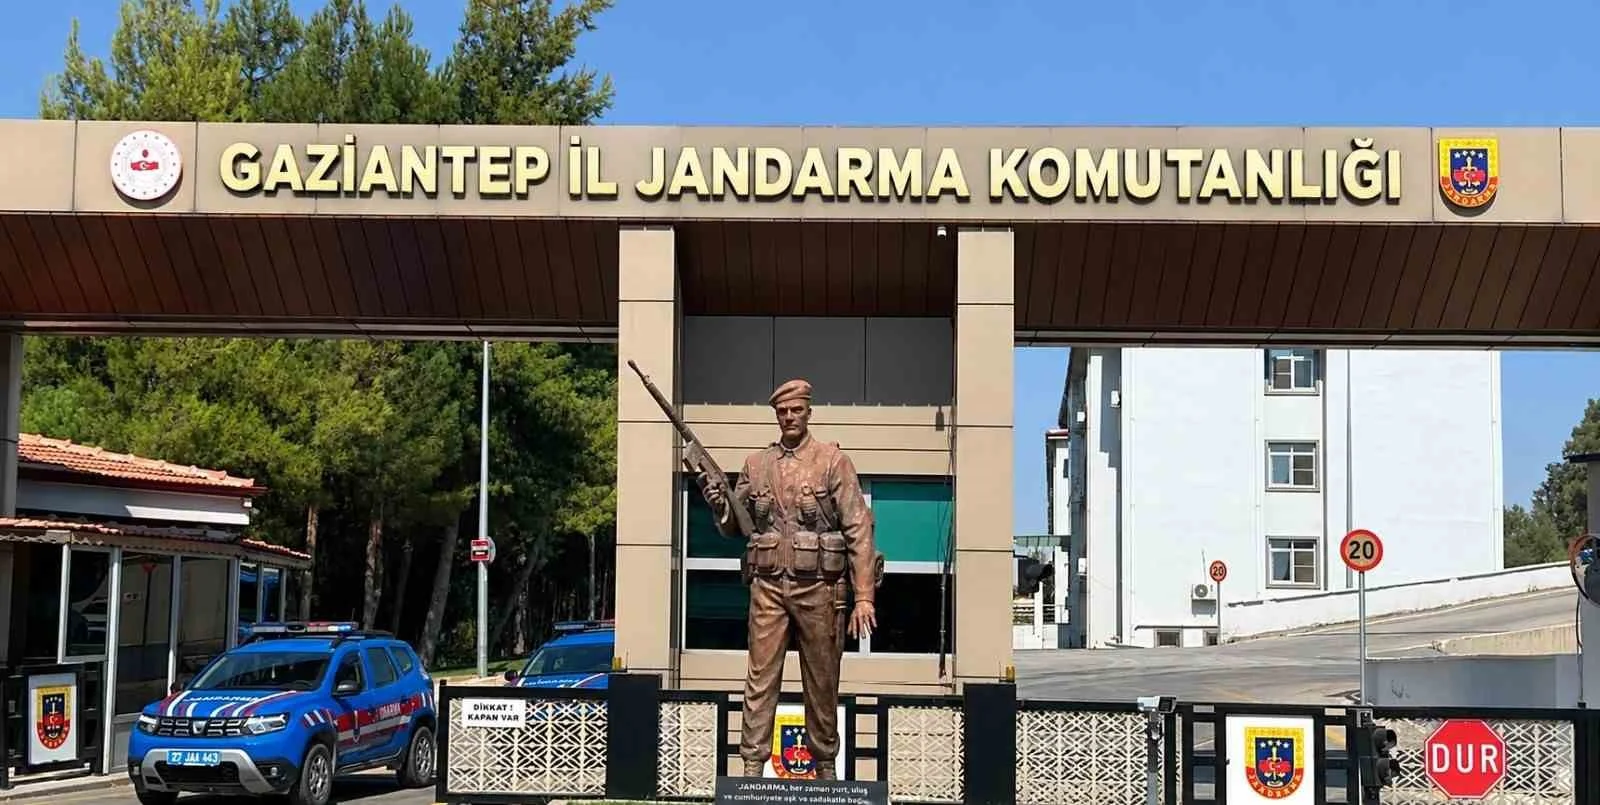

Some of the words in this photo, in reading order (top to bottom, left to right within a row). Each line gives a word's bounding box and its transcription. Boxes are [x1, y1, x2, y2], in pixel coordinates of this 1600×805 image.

[220, 134, 550, 194] GAZİANTEP
[569, 135, 618, 195] İL
[635, 146, 971, 197] JANDARMA
[989, 138, 1401, 199] KOMUTANLIĞI
[1349, 540, 1375, 560] 20
[1213, 566, 1224, 577] 20
[473, 702, 508, 711] DİKKAT
[1432, 743, 1498, 774] DUR
